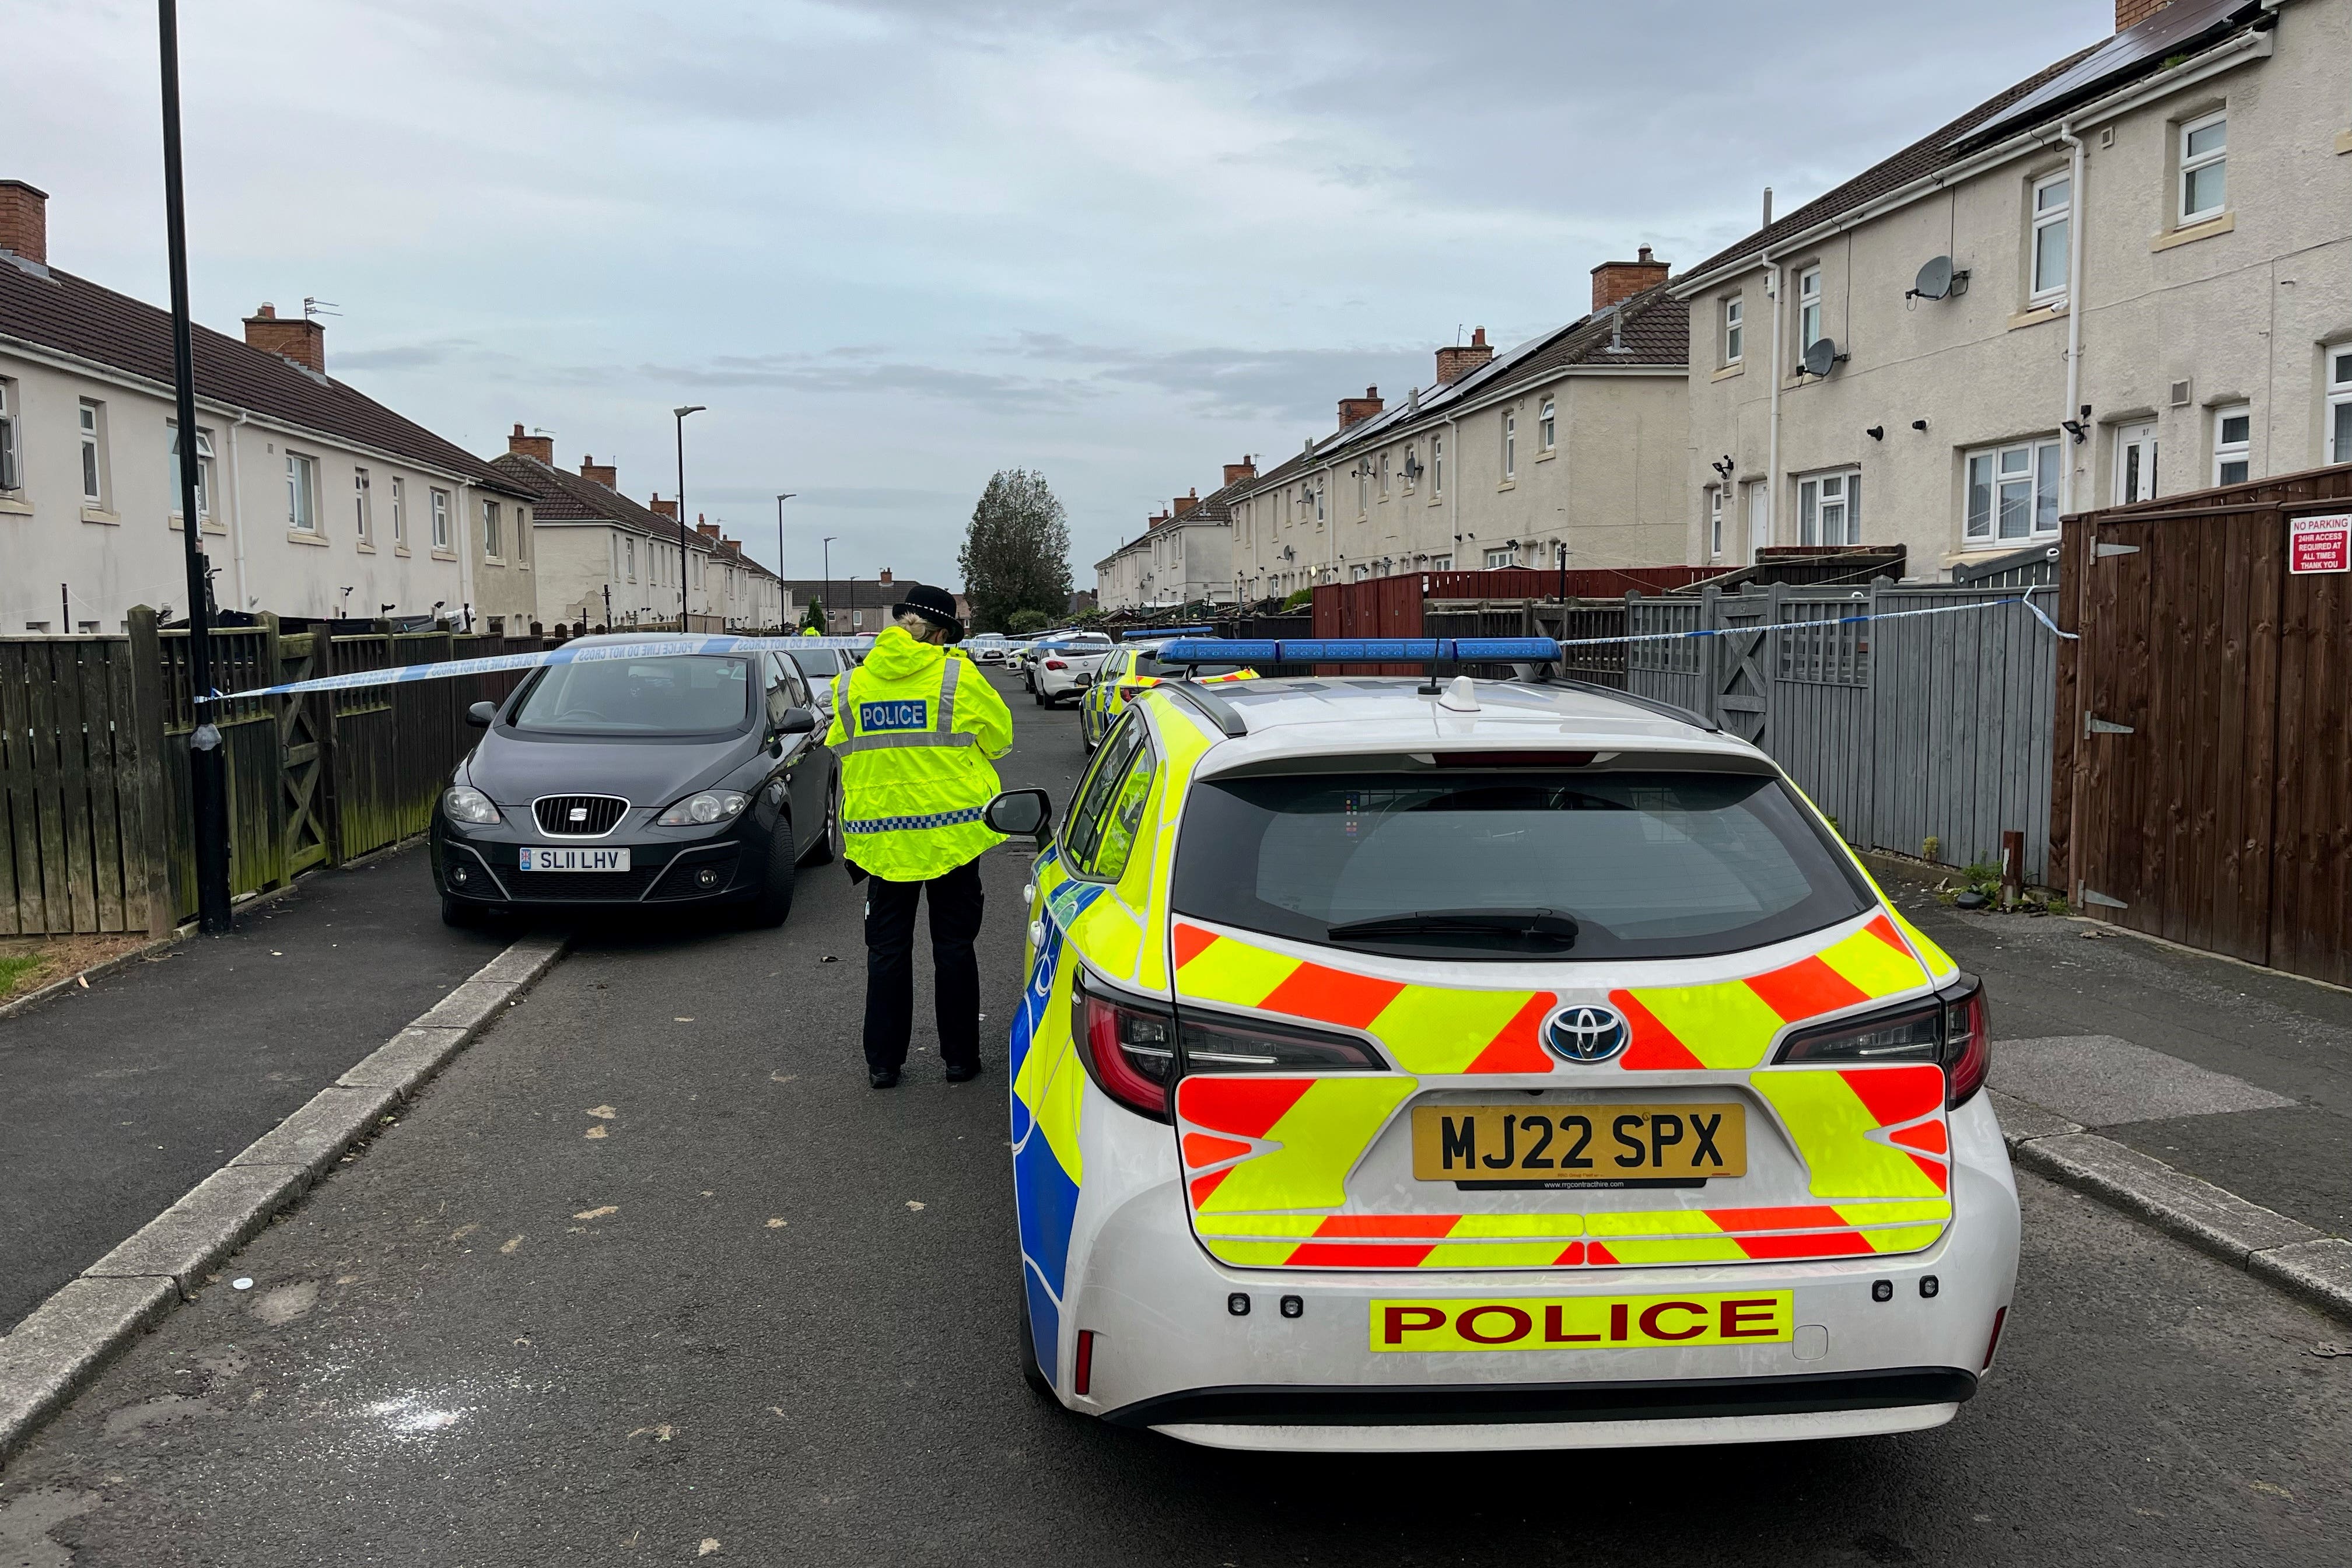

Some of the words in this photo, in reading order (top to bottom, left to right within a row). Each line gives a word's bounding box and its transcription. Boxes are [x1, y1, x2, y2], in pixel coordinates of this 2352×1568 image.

[2294, 522, 2306, 531] NO
[2308, 518, 2348, 529] PARKING
[2298, 534, 2314, 542] 24HR
[2315, 532, 2342, 541] ACCESS
[2298, 542, 2332, 551] REQUIRED
[2316, 551, 2336, 559] TIMES
[2301, 561, 2322, 569] THANK
[2323, 560, 2338, 568] YOU
[863, 705, 923, 727] POLICE
[581, 851, 618, 869] LHV
[1441, 1114, 1593, 1170] MJ22
[1612, 1114, 1724, 1168] SPX
[1544, 1181, 1624, 1189] www.rrgcontracthire.com
[1385, 1298, 1779, 1344] POLICE
